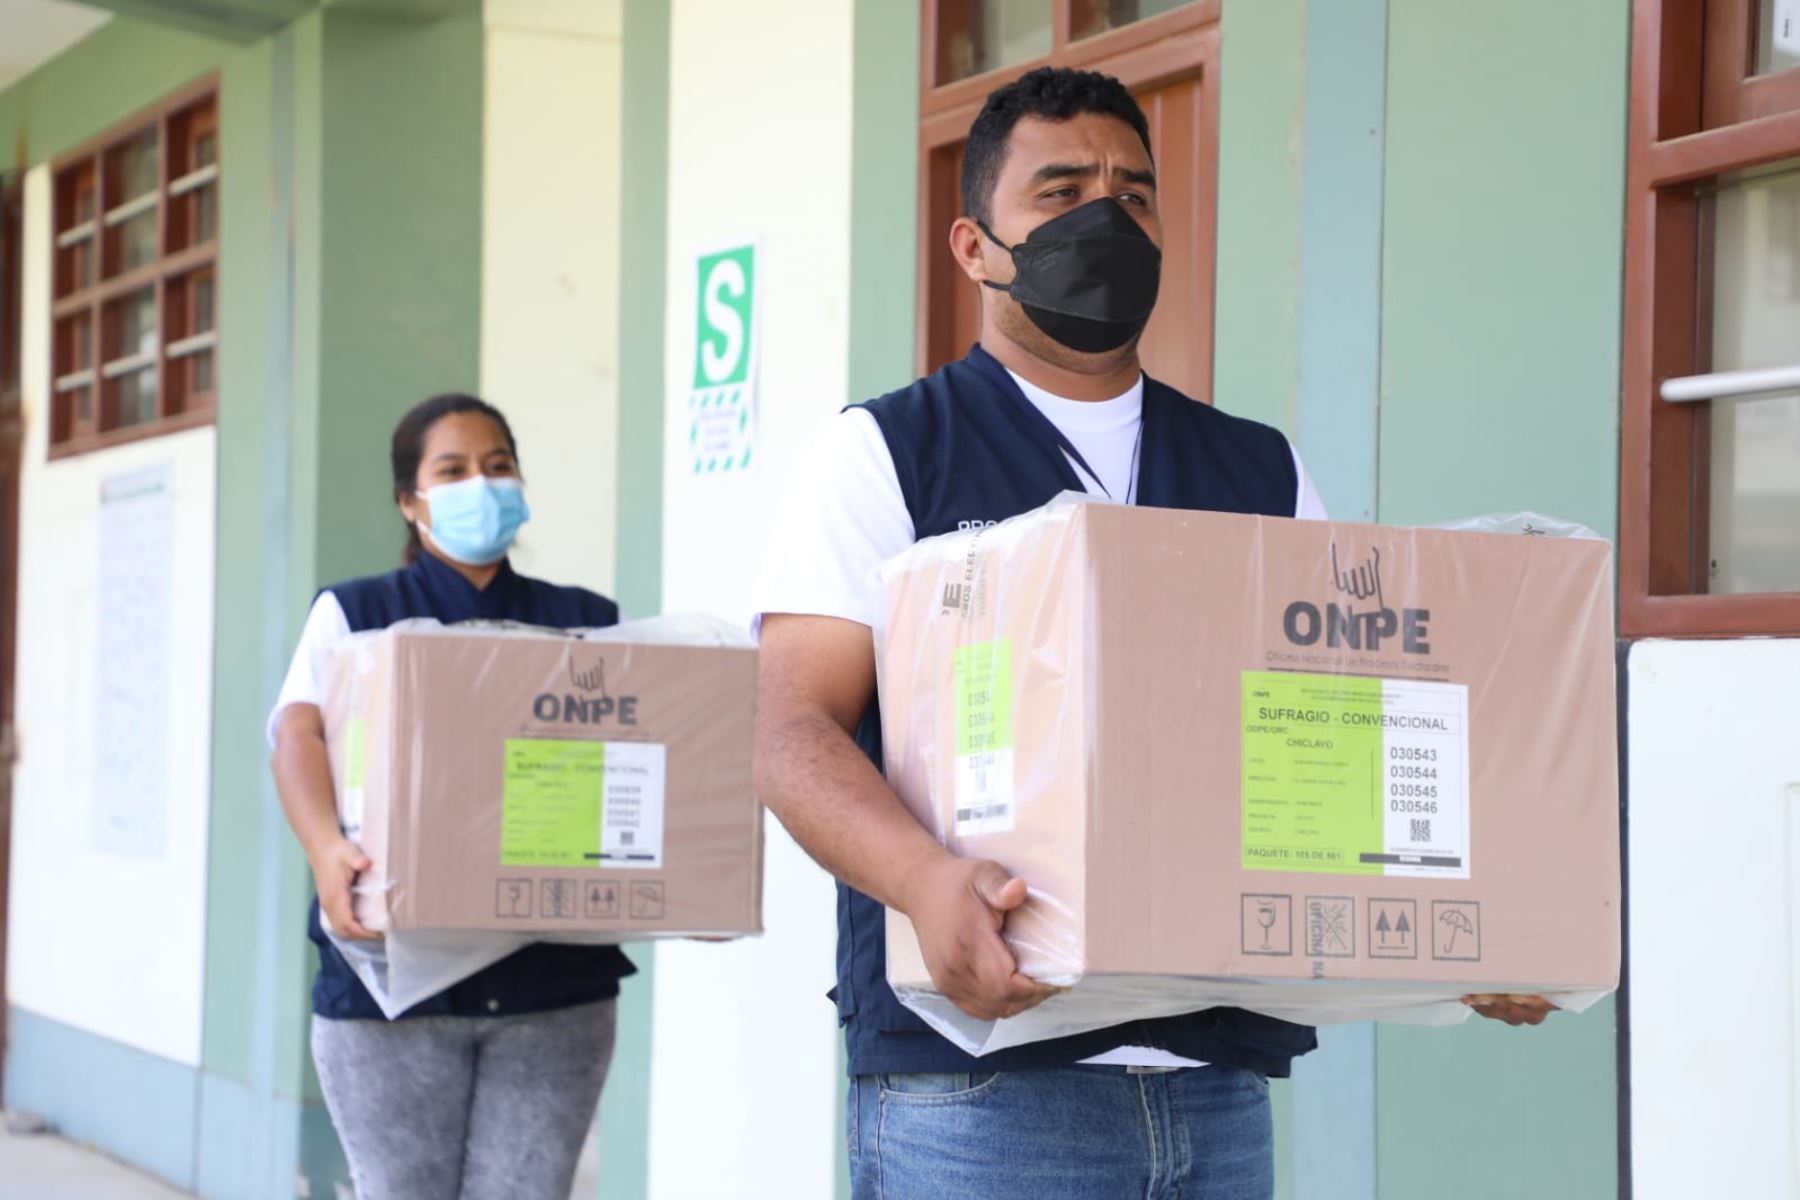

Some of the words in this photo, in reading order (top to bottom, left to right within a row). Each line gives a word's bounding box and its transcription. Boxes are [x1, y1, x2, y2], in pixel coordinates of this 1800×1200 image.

[701, 258, 745, 384] S
[1283, 601, 1431, 654] ONPE
[533, 692, 638, 726] ONPE
[1259, 707, 1330, 723] SUFRAGIO
[1341, 712, 1449, 731] CONVENCIONAL
[1286, 738, 1334, 750] CHICLAYO
[1390, 747, 1438, 762] 030543
[1390, 765, 1438, 780] 030544
[1390, 783, 1438, 798] 030545
[1390, 799, 1438, 814] 030546
